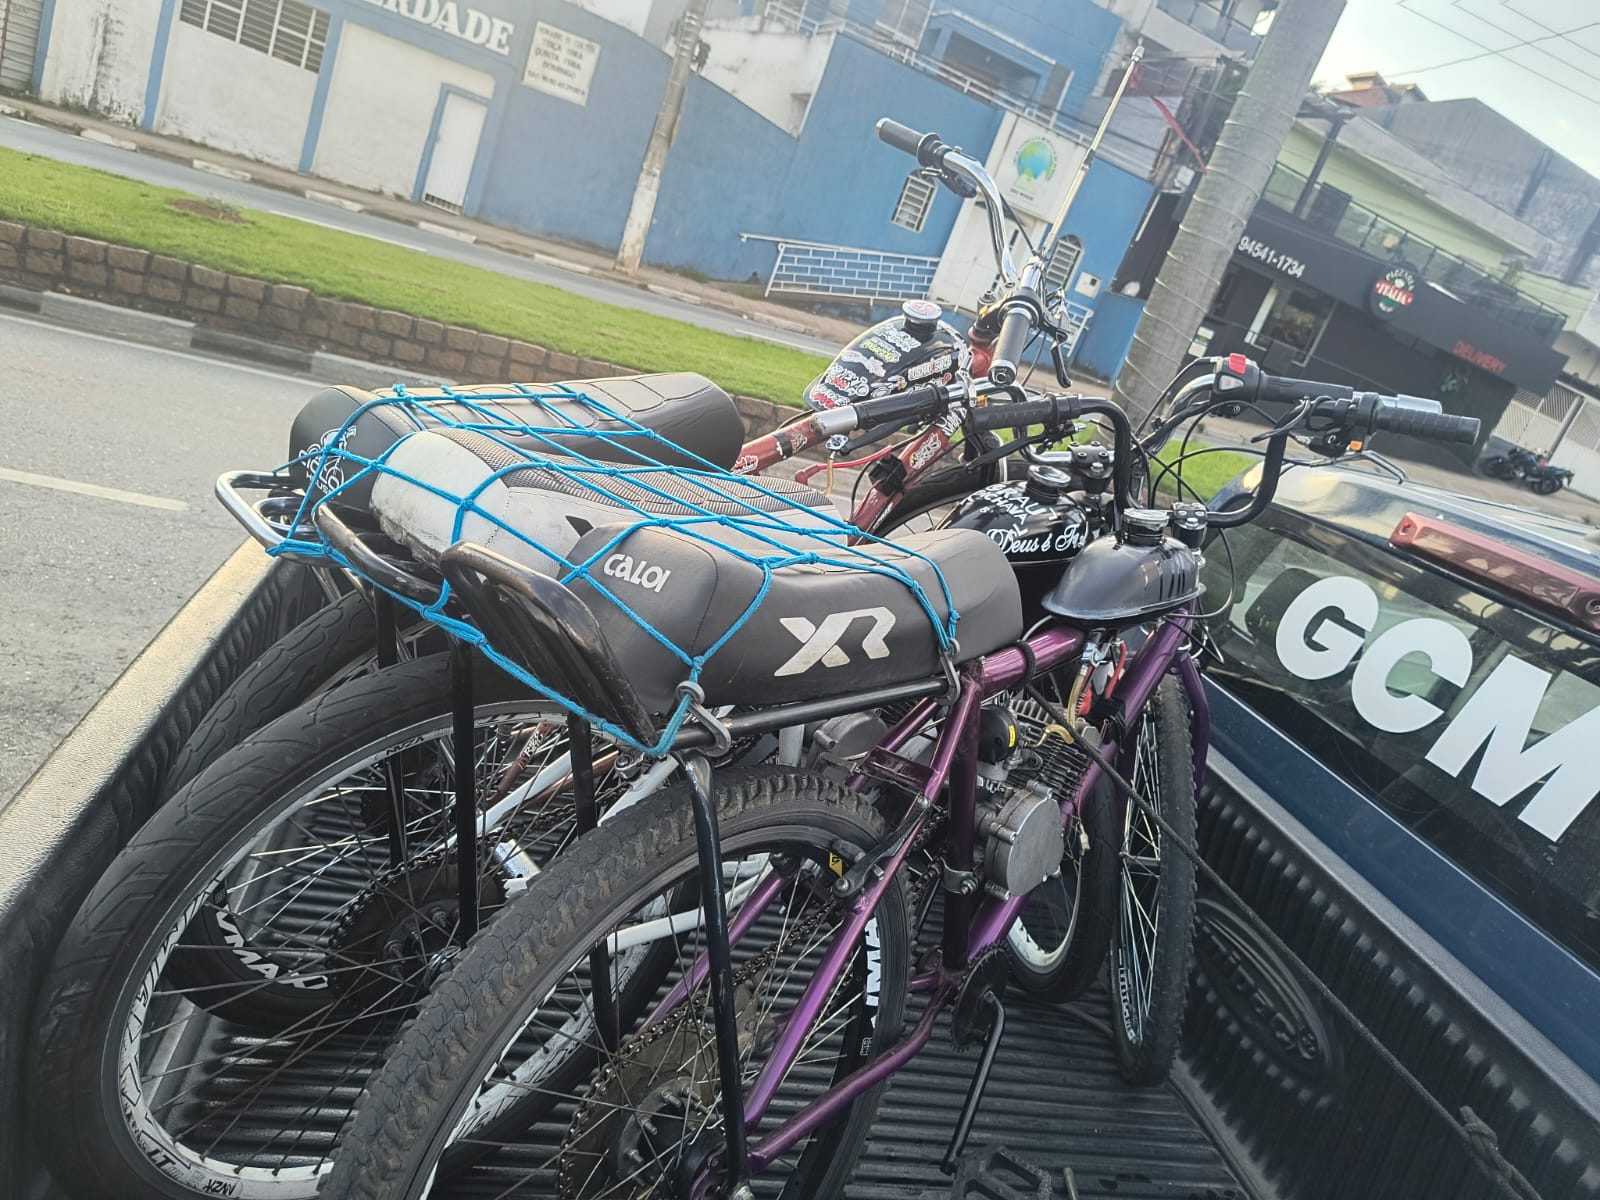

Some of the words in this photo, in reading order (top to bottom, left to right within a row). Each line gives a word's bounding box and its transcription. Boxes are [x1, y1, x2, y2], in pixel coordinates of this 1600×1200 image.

[373, 0, 514, 56] DADE
[1237, 235, 1306, 279] 94541-1734
[1454, 341, 1509, 374] DELIVERY
[1276, 576, 1600, 842] GCM
